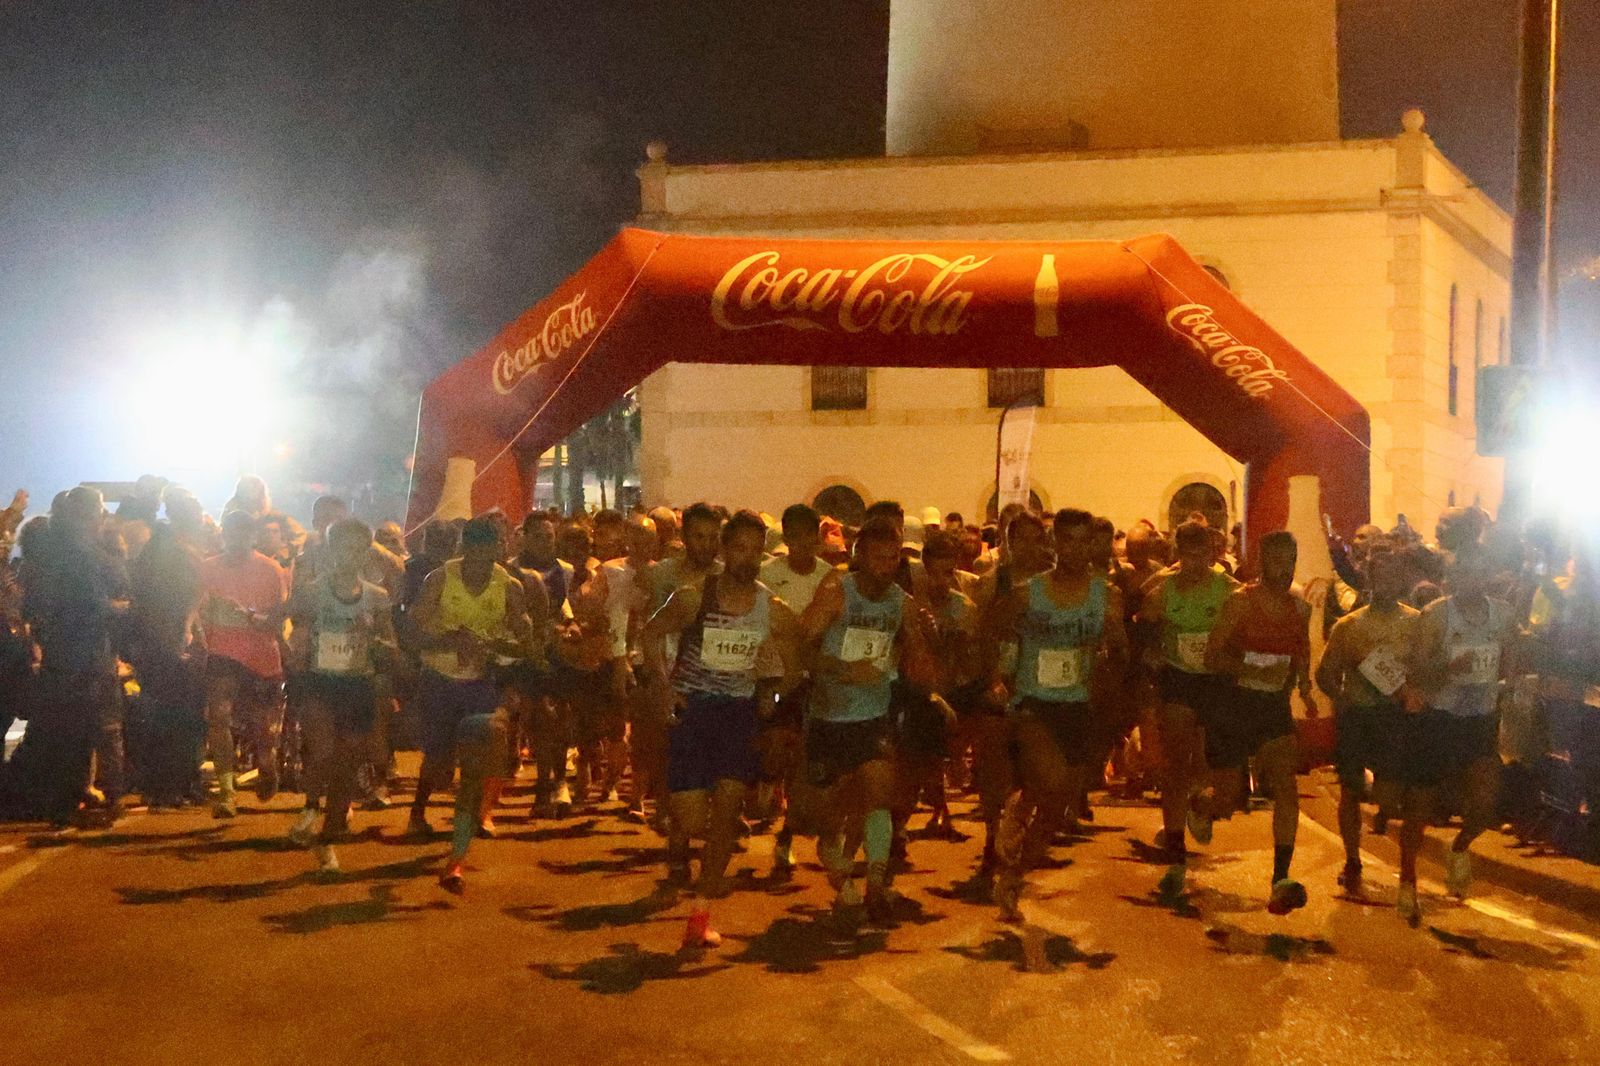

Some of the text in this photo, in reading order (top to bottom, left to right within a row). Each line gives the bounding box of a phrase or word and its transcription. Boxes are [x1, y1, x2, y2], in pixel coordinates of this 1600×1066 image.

[711, 250, 993, 335] Coca-Cola
[492, 288, 595, 395] Coca-Cola
[1166, 303, 1293, 400] Coca-Cola
